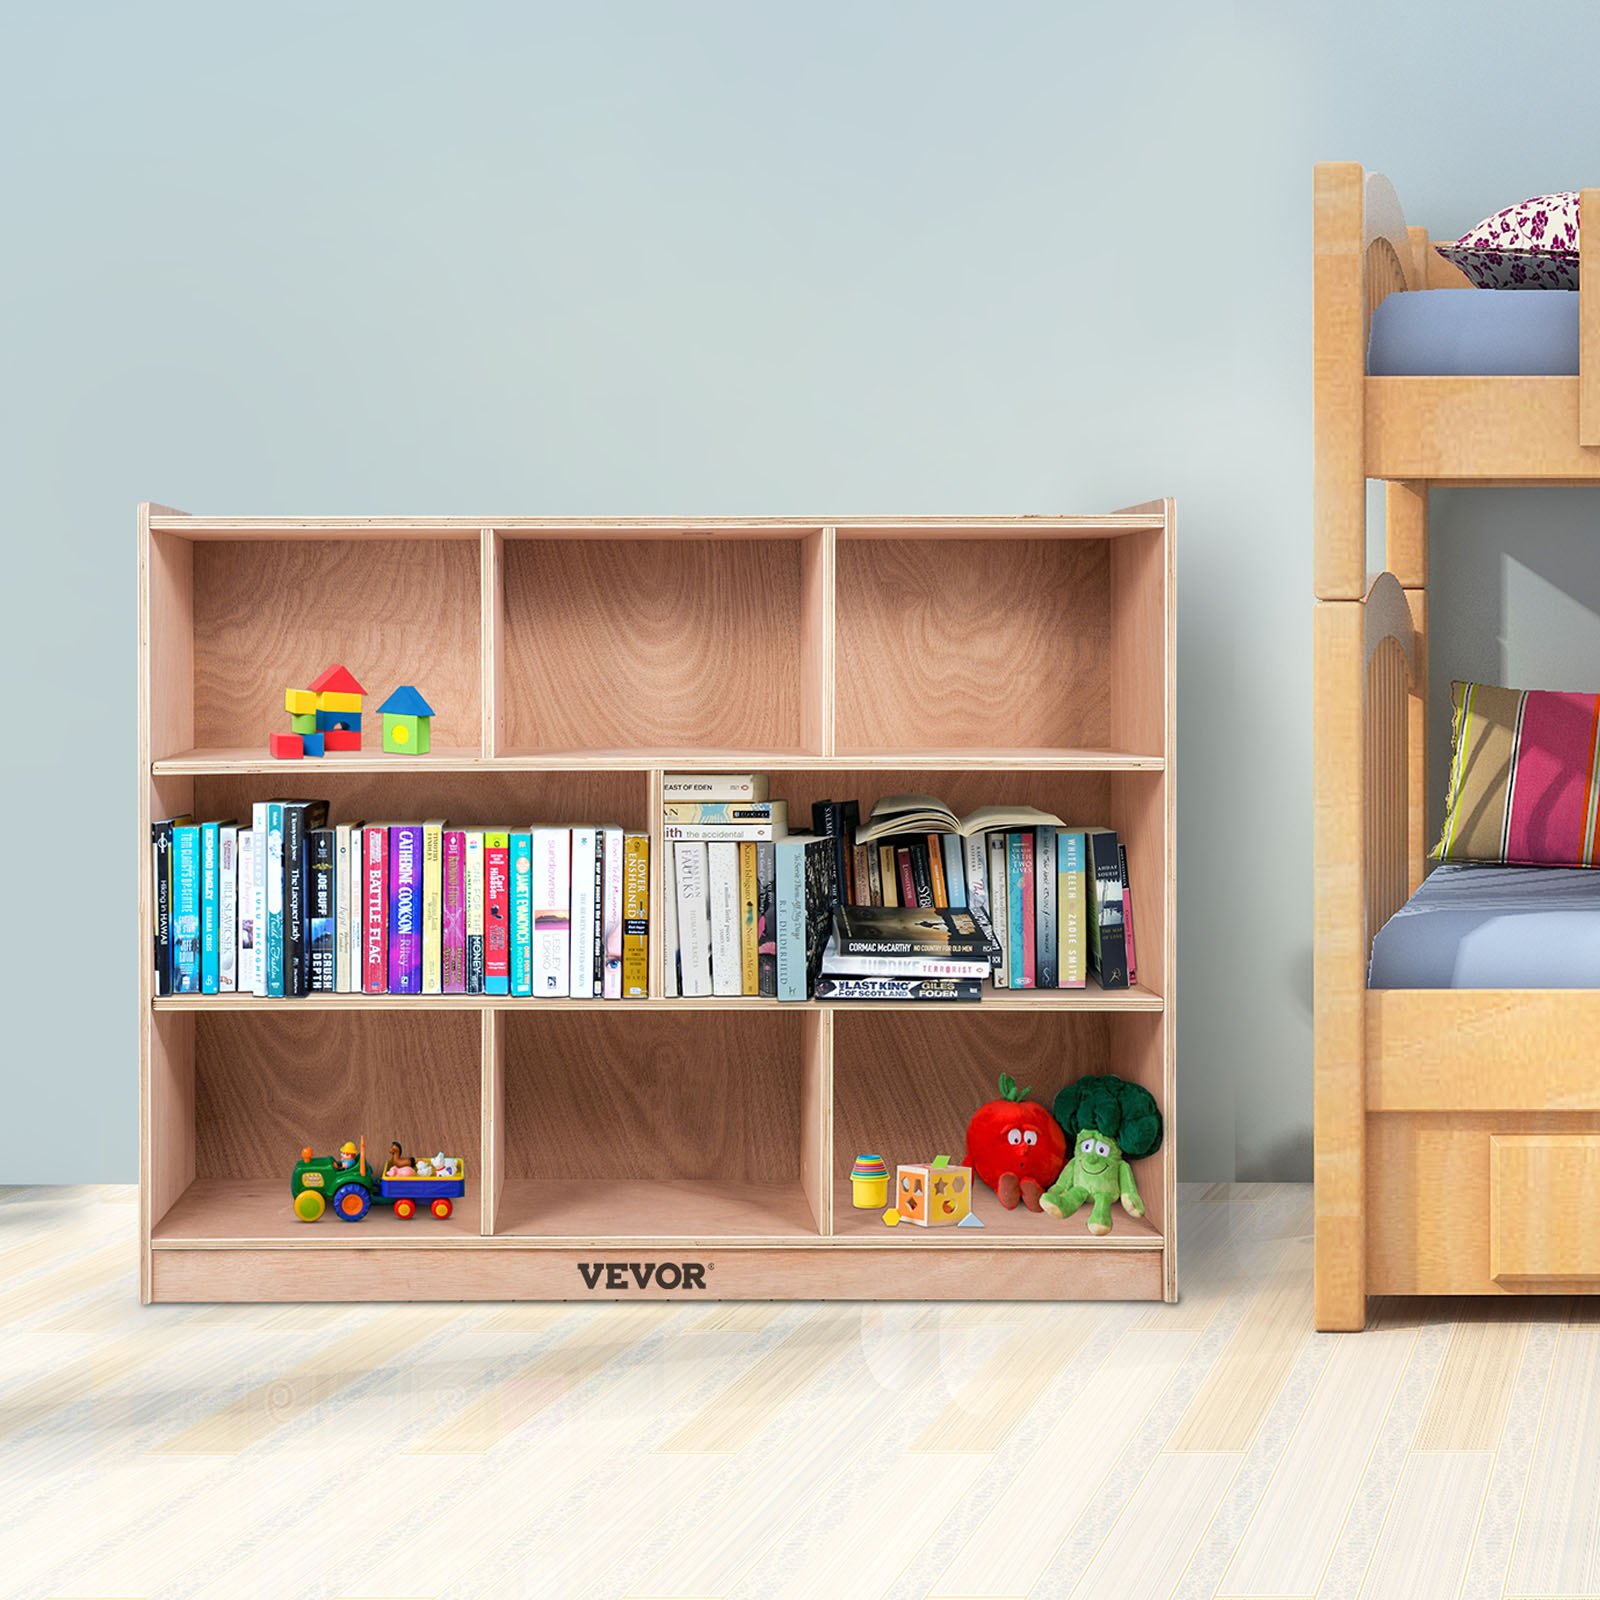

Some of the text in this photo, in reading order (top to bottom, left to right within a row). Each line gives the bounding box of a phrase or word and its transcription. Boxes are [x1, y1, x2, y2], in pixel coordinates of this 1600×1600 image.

[686, 830, 700, 838] the
[701, 830, 745, 838] accidental
[497, 875, 505, 892] Carl
[547, 840, 558, 907] sundowners
[627, 853, 638, 918] ENSHRINED
[637, 859, 647, 892] LOVER
[682, 849, 694, 899] FAULKS
[693, 848, 701, 898] SEBASTIAN
[743, 844, 754, 901] Kazuo Ishiguro
[160, 879, 168, 901] Hiking
[224, 881, 234, 900] BILL
[318, 873, 328, 915] JOE BUFF
[370, 870, 382, 923] BATTLE
[398, 831, 414, 967] CATHERINE COOKSON Riley
[472, 887, 482, 911] FOR
[972, 879, 984, 897] The
[160, 904, 167, 912] in
[255, 892, 263, 920] LULU
[289, 869, 300, 943] The Lacquer Lady
[516, 873, 529, 945] JANET EVANOVICH
[1067, 838, 1077, 982] WHITE TEETH ZADIE SMITH
[222, 902, 234, 955] SLAVICSEK
[472, 914, 482, 934] THE
[690, 910, 698, 940] HUMAN
[723, 924, 731, 943] pieces
[745, 927, 753, 946] Never
[370, 928, 382, 963] FLAG
[471, 936, 481, 973] MONEY
[551, 933, 561, 971] LESLEY
[746, 947, 754, 958] Let
[778, 920, 788, 986] DELDERFIELD
[849, 943, 876, 952] CORMAC
[877, 943, 912, 953] McCARTHY
[313, 953, 323, 989] DEPTH
[323, 953, 333, 989] CRUSH
[747, 970, 754, 981] Go
[922, 965, 972, 974] TERRORIST
[845, 981, 910, 990] LAST KING
[919, 990, 958, 998] FODEN
[921, 982, 955, 990] GILES
[577, 1262, 706, 1290] VEVOR
